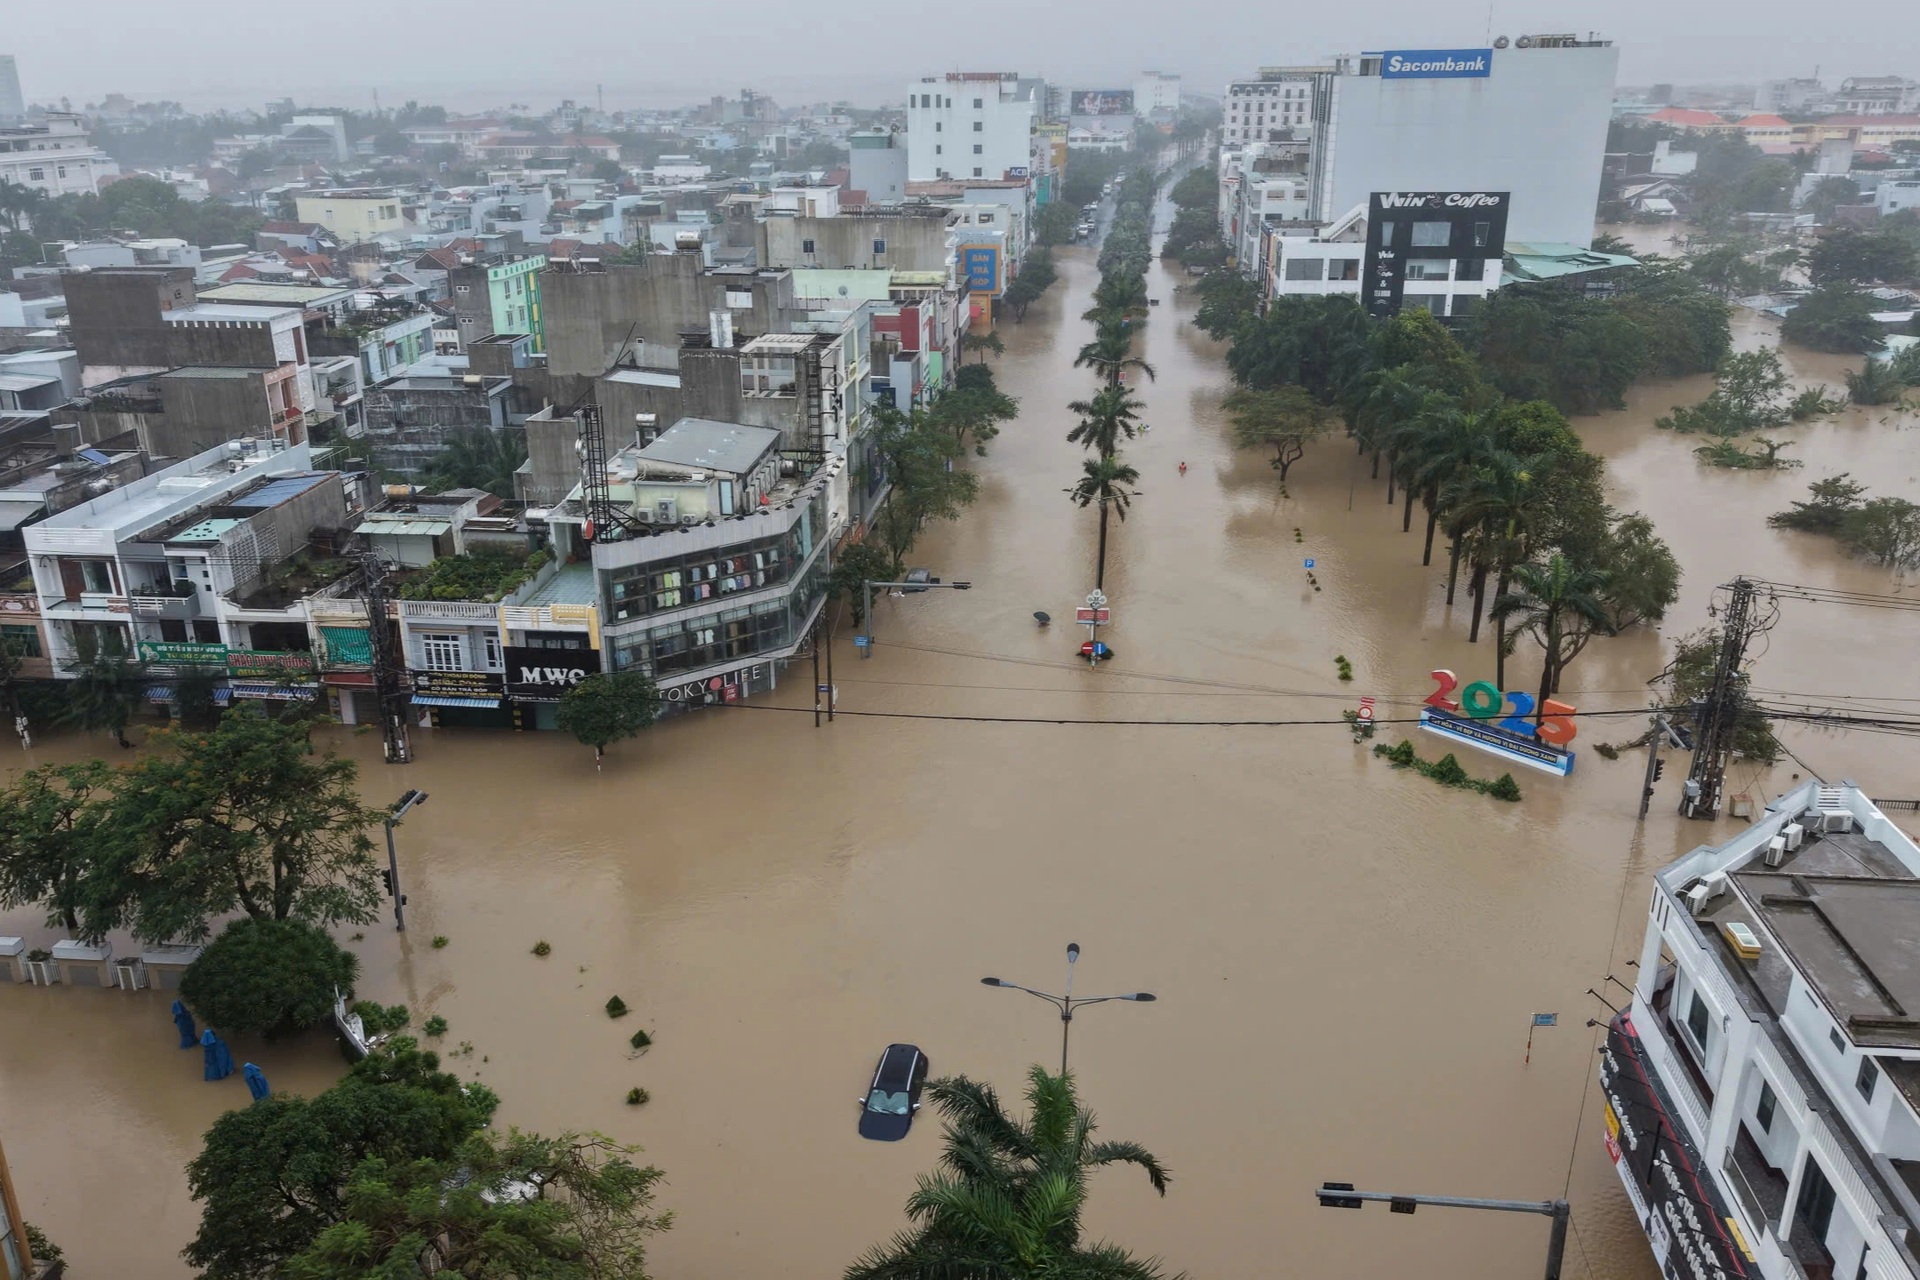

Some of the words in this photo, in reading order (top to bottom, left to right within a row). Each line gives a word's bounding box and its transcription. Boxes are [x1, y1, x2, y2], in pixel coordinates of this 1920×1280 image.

[1388, 55, 1486, 73] Sacombank
[1010, 168, 1027, 176] ACB
[1444, 193, 1500, 208] Coffee
[1423, 669, 1577, 745] 2025
